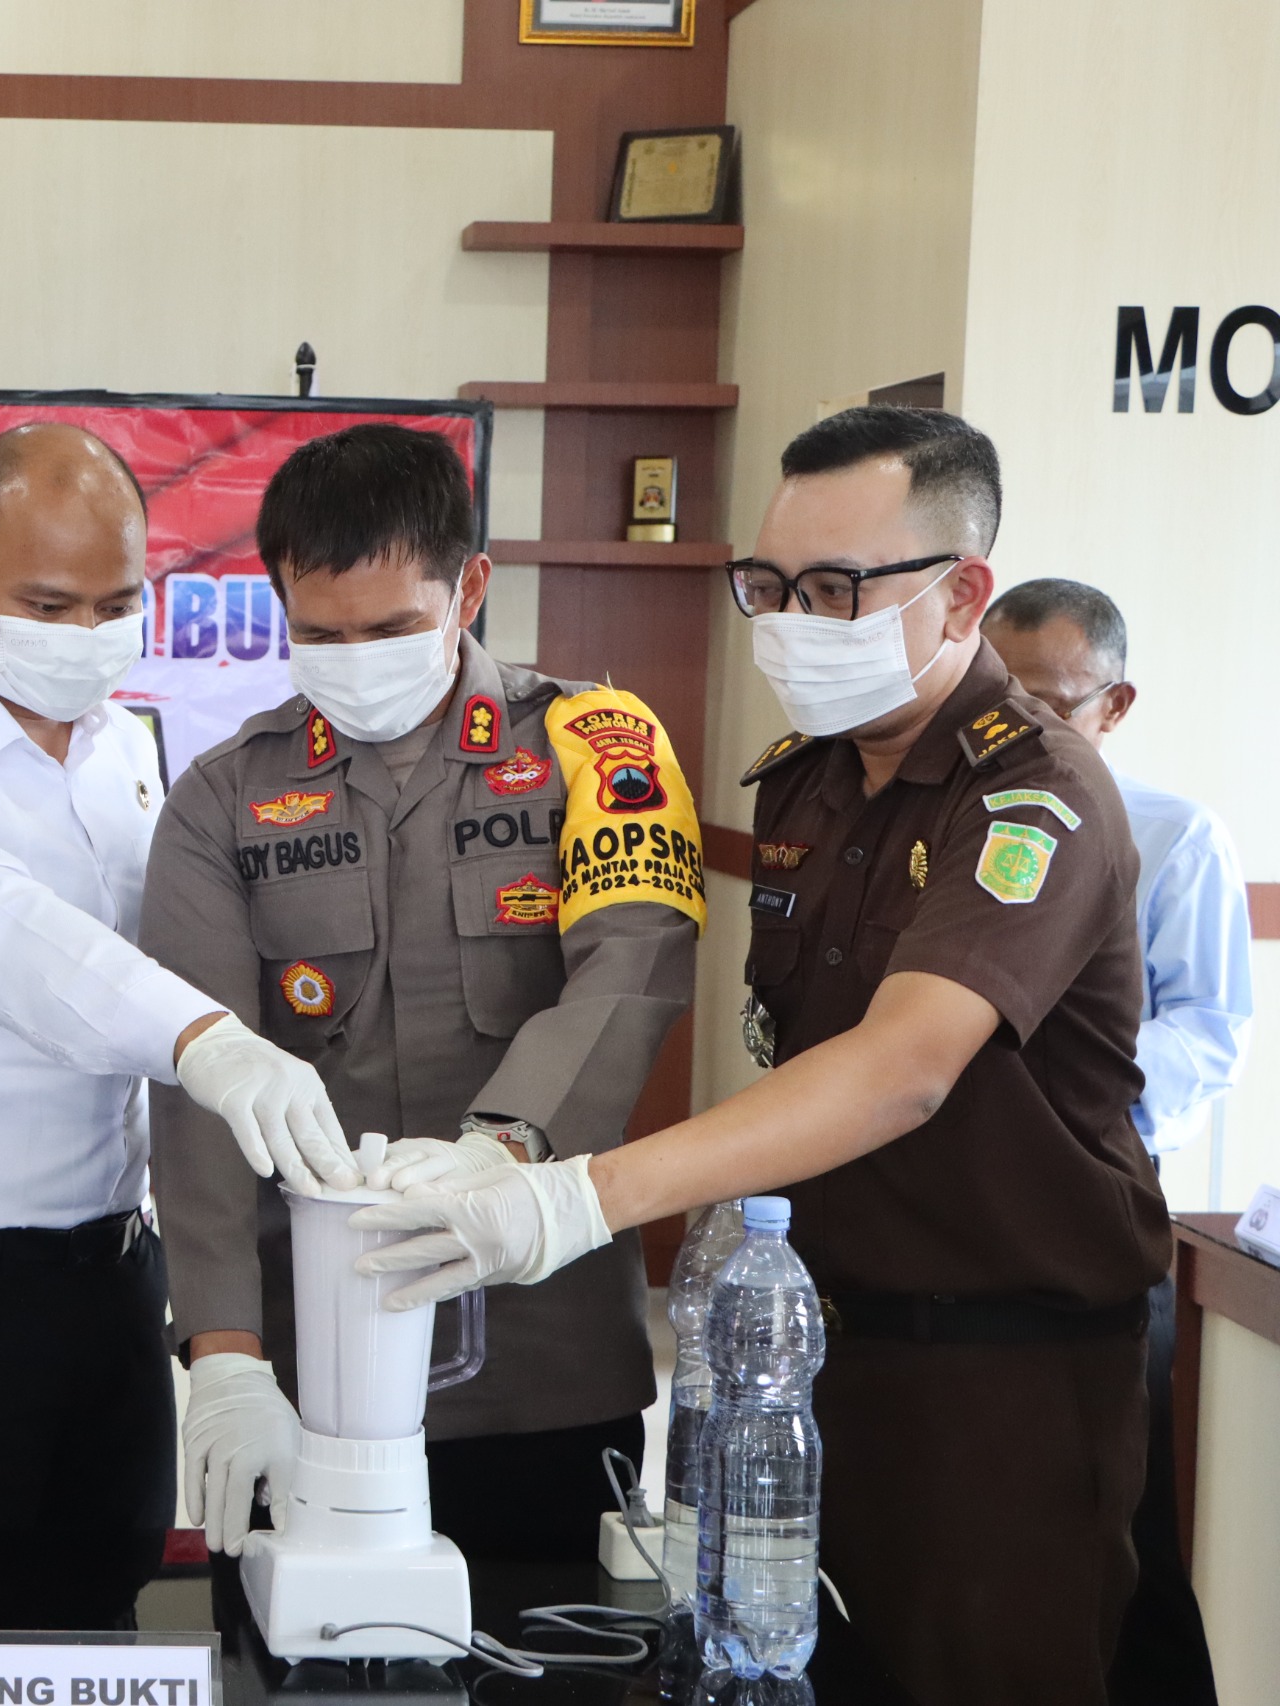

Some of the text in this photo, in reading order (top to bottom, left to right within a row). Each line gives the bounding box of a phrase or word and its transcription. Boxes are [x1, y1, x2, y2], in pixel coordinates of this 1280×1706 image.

[574, 712, 648, 732] POLRES
[275, 831, 361, 875] BAGUS
[581, 858, 639, 886] MANTAP
[644, 858, 686, 883] PRAJA
[511, 909, 546, 919] SNIPER
[70, 1678, 198, 1706] BUKTI
